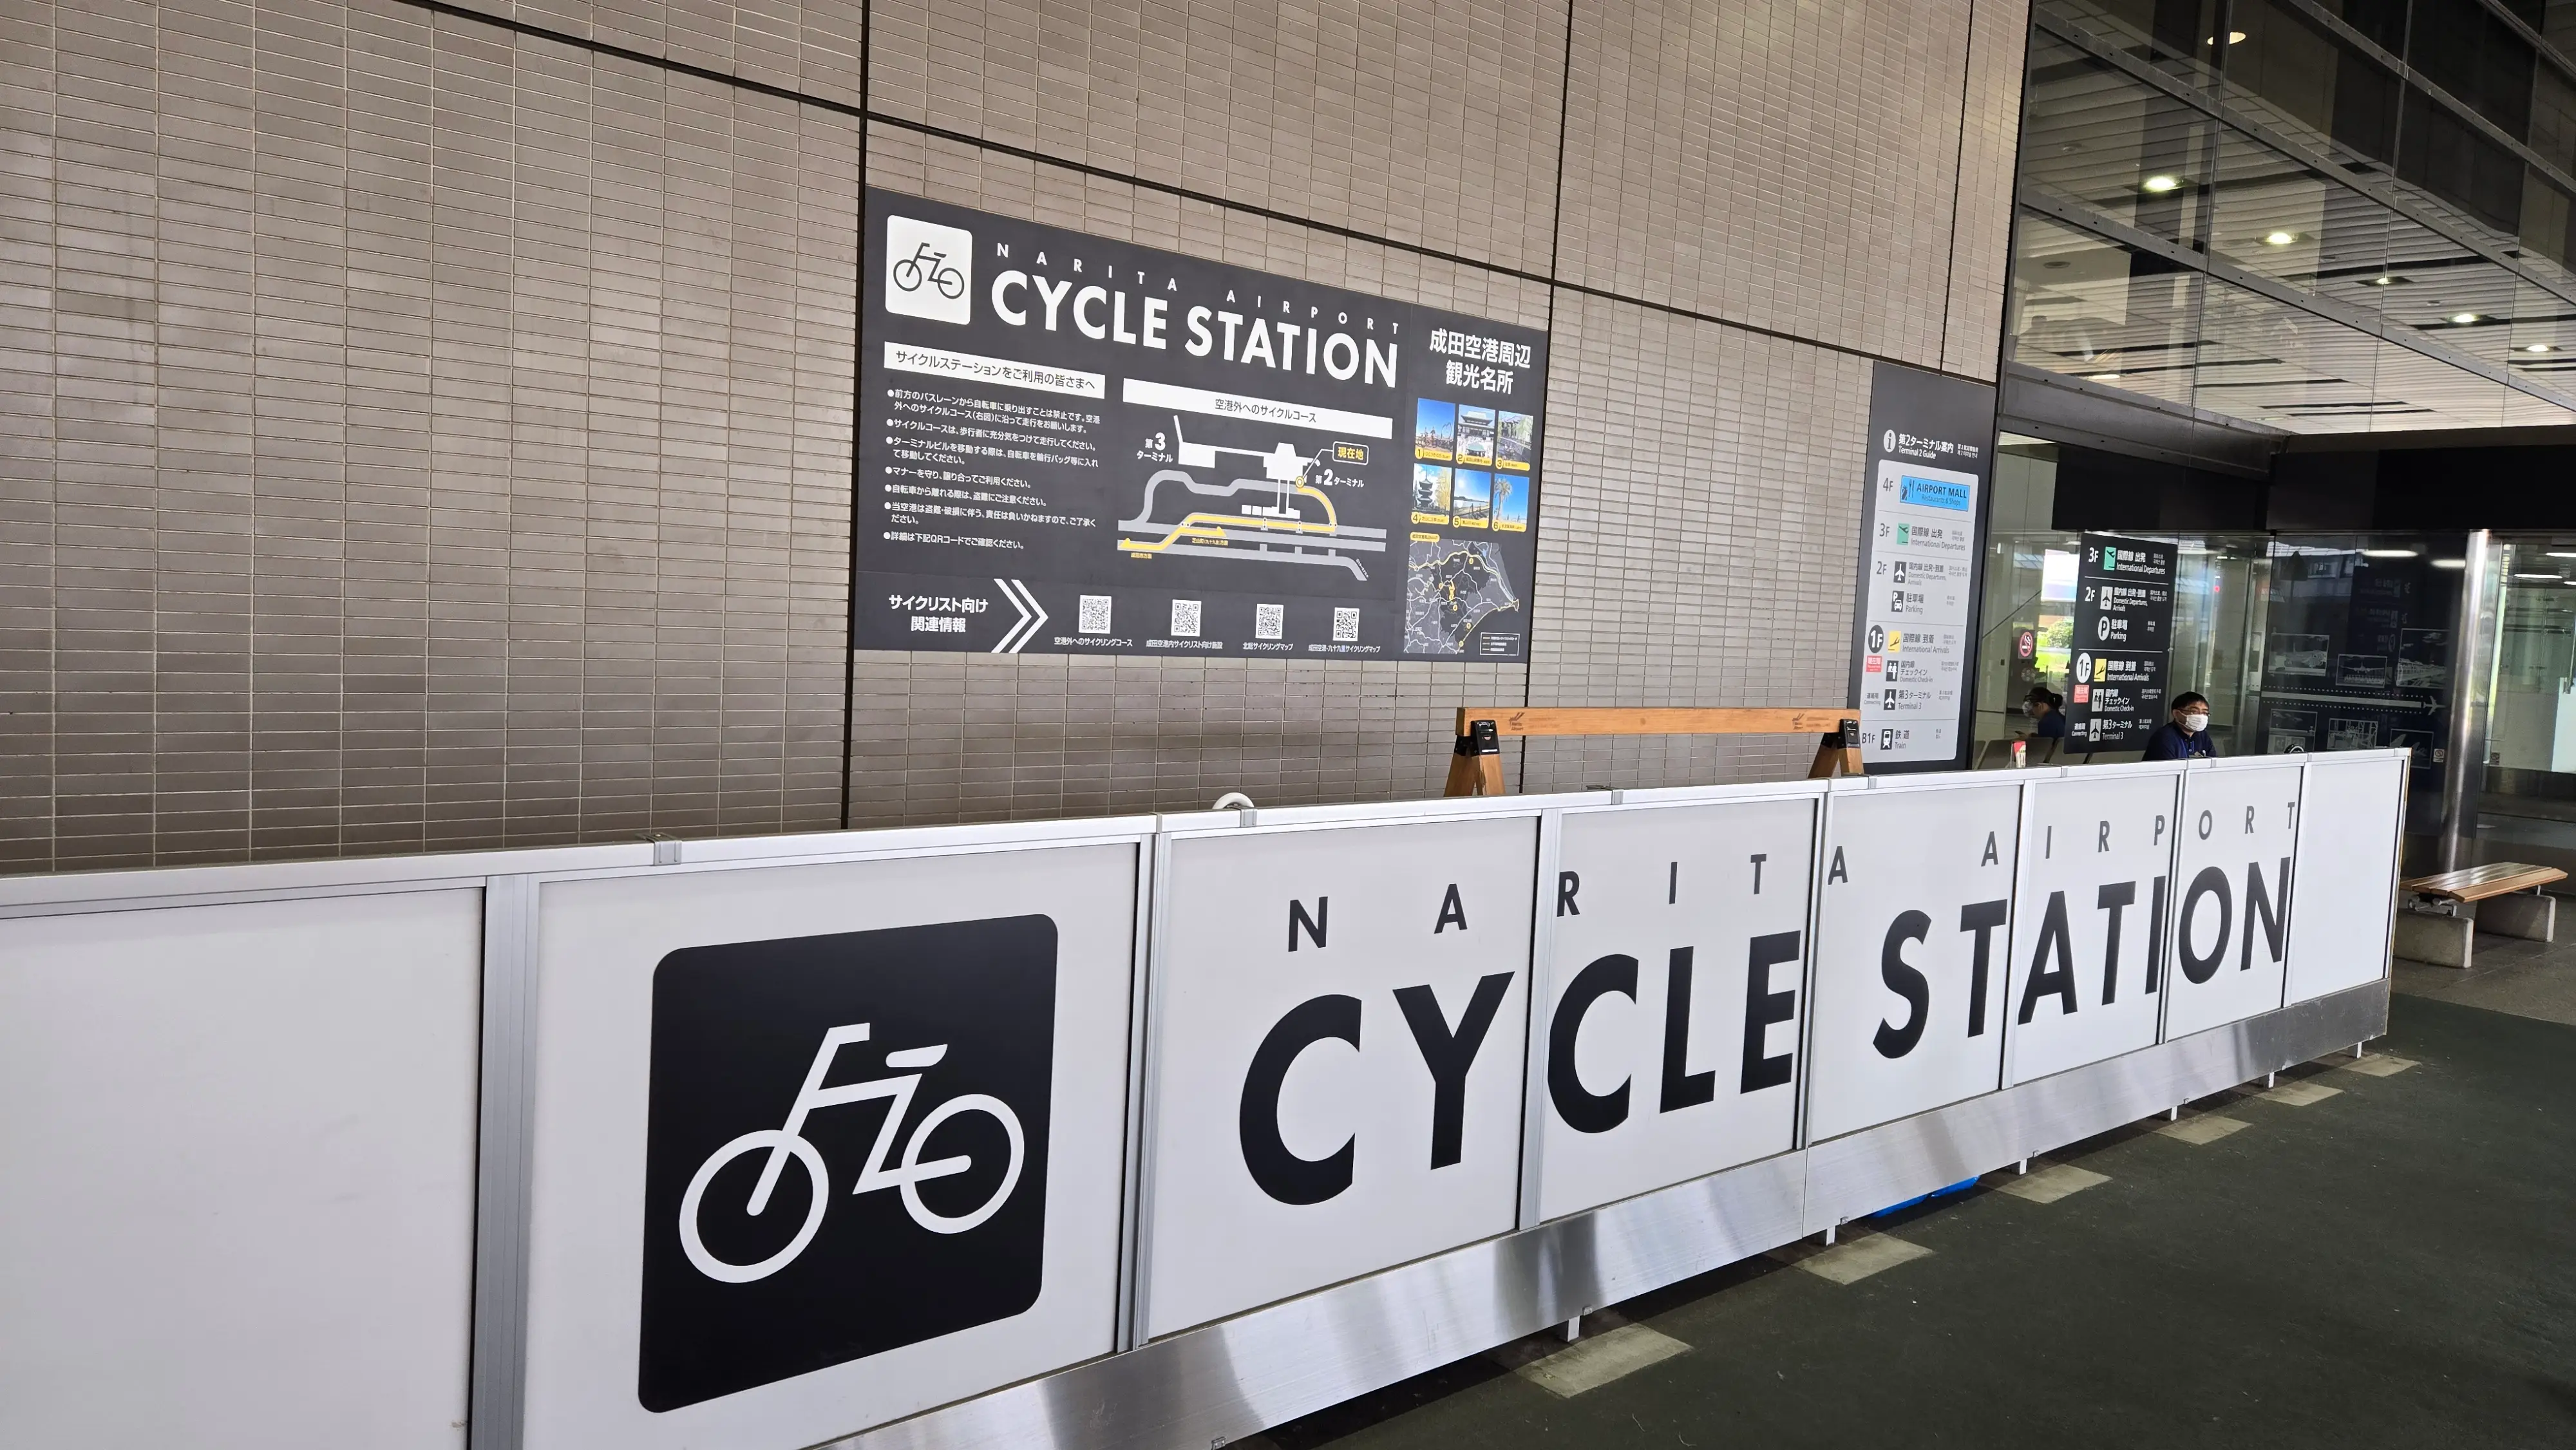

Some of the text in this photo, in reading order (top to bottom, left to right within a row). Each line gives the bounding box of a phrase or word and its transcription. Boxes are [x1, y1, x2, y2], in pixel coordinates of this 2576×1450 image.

[997, 243, 1399, 334] NARITA AIRPORT
[991, 270, 1397, 388] CYCLE STATION
[1429, 328, 1531, 369] 成田空港周辺
[896, 350, 1095, 390] サイクルステーションをご利用の皆さまへ
[1446, 360, 1513, 395] 観光名所
[1215, 397, 1317, 423] 空港外へのサイクルコース
[1899, 433, 1954, 453] 第2ターミナル案内
[1137, 451, 1173, 463] ターミナル
[1338, 447, 1365, 461] 現在地
[1899, 446, 1919, 457] Terminal
[1922, 450, 1937, 459] Guide
[1883, 477, 1893, 492] 4F
[1917, 484, 1967, 498] AIRPORT MALL
[1922, 494, 1945, 504] Restaurants
[1949, 498, 1961, 506] Shops
[891, 514, 919, 525] ださい。
[1879, 523, 1890, 537] 3F
[1911, 538, 1965, 551] International Departures
[2088, 547, 2099, 563] 3F
[1877, 561, 1887, 575] 2F
[2116, 562, 2166, 574] International Departures
[2085, 587, 2096, 602] 2F
[889, 594, 989, 614] サイクリスト向け
[1906, 605, 1923, 614] Parking
[911, 616, 966, 633] 関連情報
[1871, 630, 1883, 648] 1F
[2110, 631, 2126, 642] Parking
[2079, 659, 2090, 677] 1F
[2107, 673, 2134, 681] International
[1899, 690, 1932, 700] 第3ターミナル
[1862, 733, 1876, 744] B1F
[2102, 731, 2124, 740] Terminal 3
[1288, 802, 2296, 952] NARITA AIRPORT
[1239, 856, 2291, 1206] CYCLE STATION
